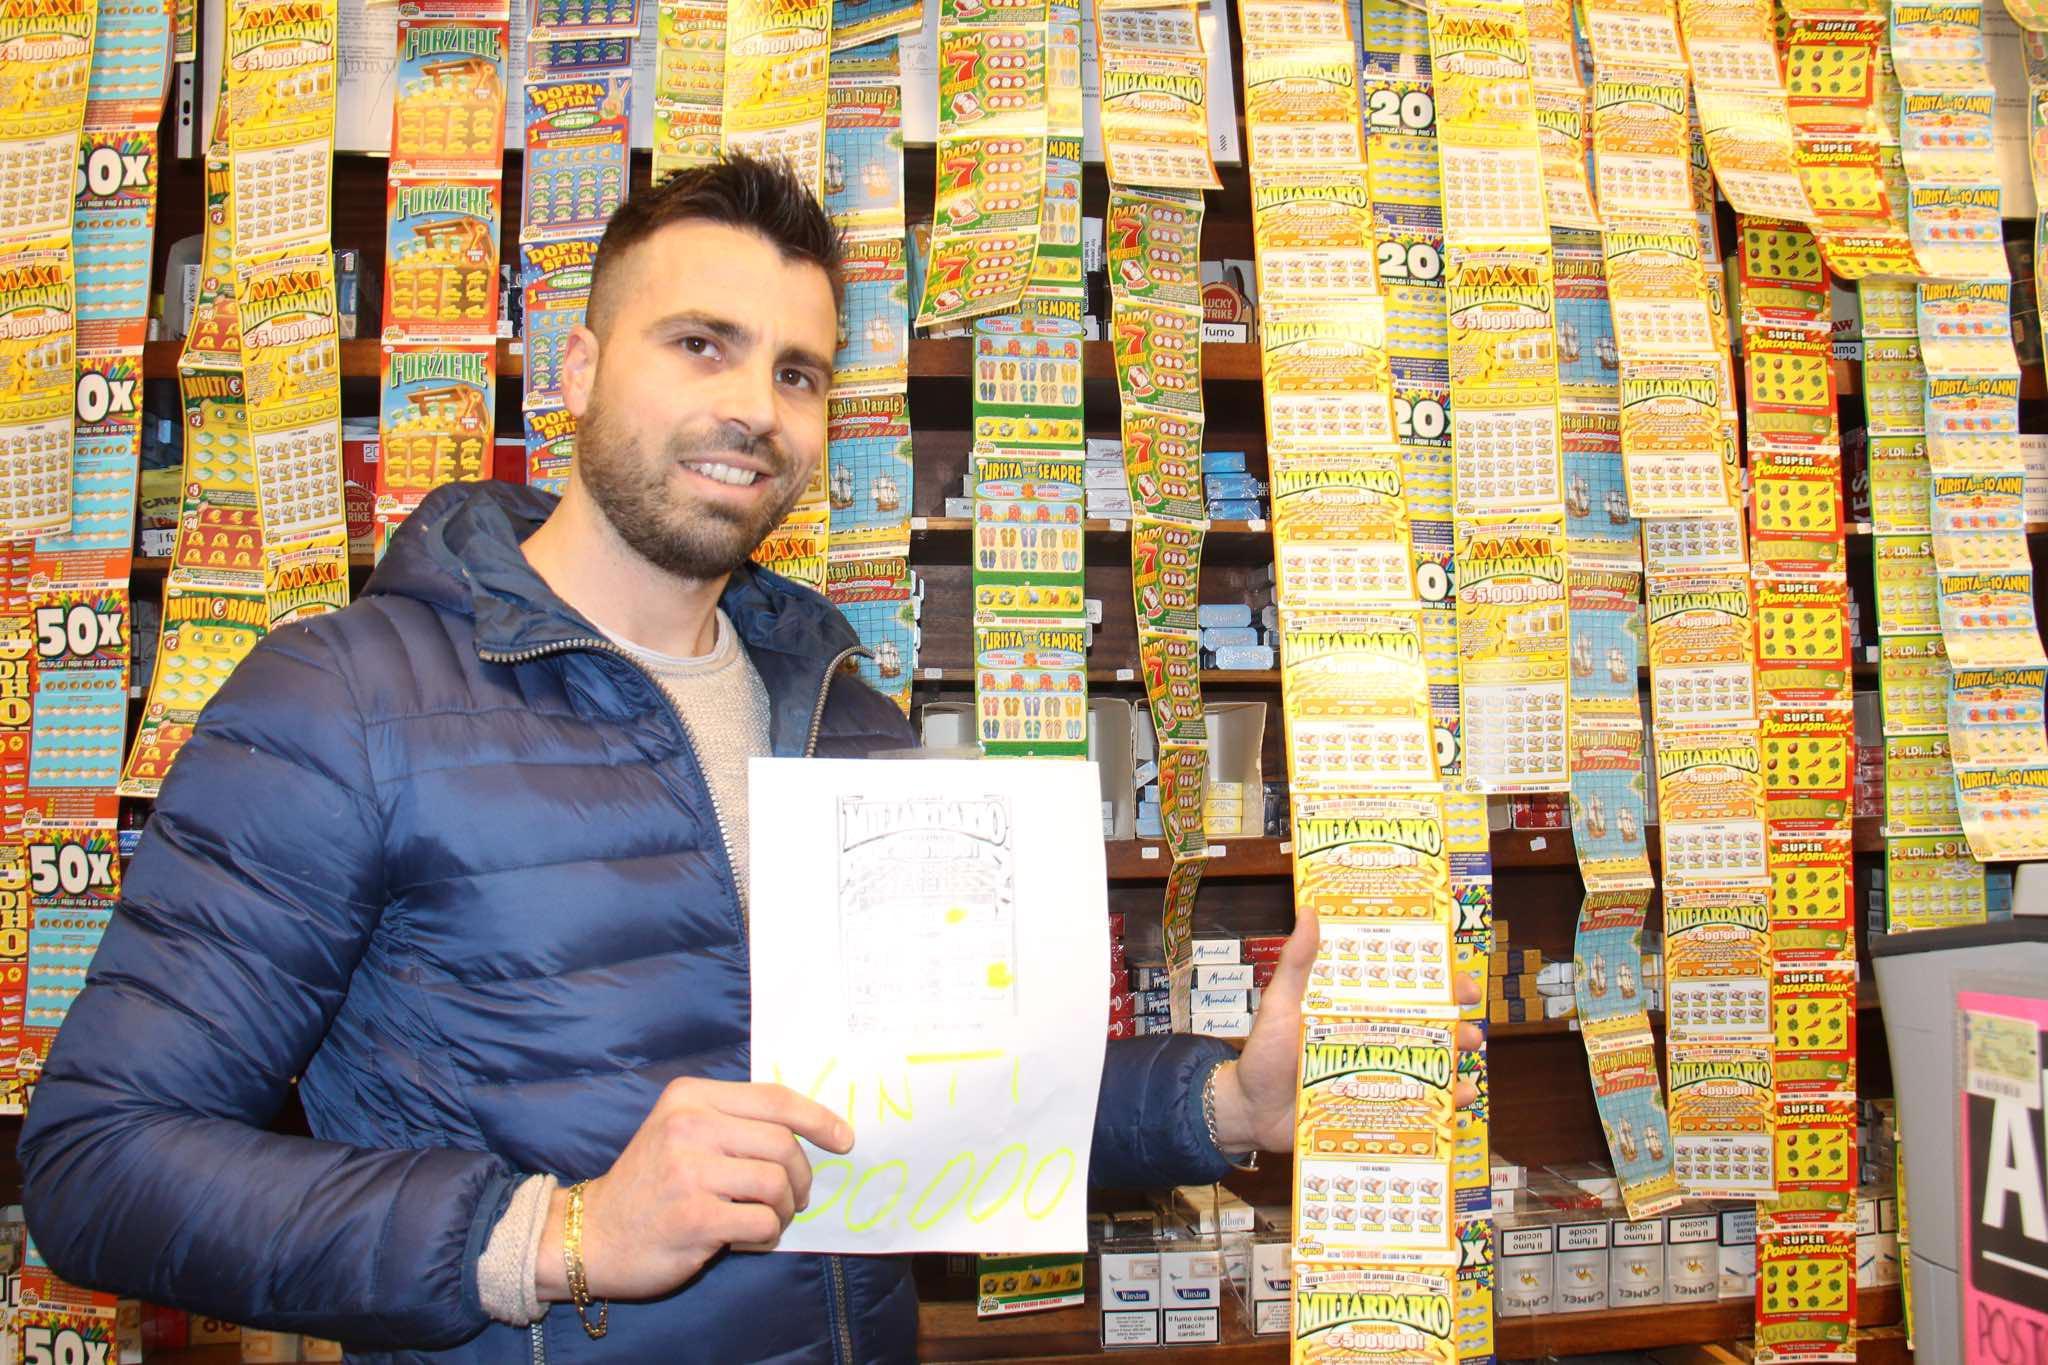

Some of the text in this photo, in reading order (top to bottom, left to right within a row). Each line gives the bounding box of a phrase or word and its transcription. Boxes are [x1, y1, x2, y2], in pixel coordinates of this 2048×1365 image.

[6, 0, 83, 17] MAXI
[244, 3, 322, 26] MAXI
[232, 16, 333, 59] MILIARDARIO
[1442, 18, 1515, 39] MAXI
[1815, 22, 1856, 32] SUPER
[405, 26, 502, 63] FORZIERE
[943, 32, 982, 52] DADO
[1433, 31, 1526, 64] MILIARDARIO
[234, 46, 334, 72] €5.000.000!
[947, 50, 981, 83] 7
[1248, 62, 1352, 88] MILIARDARIO
[532, 82, 604, 105] DOPPIA
[1104, 71, 1204, 105] MILIARDARIO
[1595, 81, 1685, 115] MILIARDARIO
[546, 96, 597, 114] SFIDA
[943, 140, 980, 159] DADO
[1812, 143, 1853, 154] SUPER
[946, 156, 979, 188] 7
[396, 185, 493, 221] FORZIERE
[1256, 185, 1368, 212] MILIARDARIO
[1115, 217, 1143, 249] 7
[527, 241, 598, 264] DOPPIA
[936, 241, 974, 264] DADO
[1606, 232, 1697, 260] MILIARDARIO
[541, 255, 591, 273] SFIDA
[936, 255, 971, 282] 7
[251, 270, 322, 299] MAXI
[1462, 265, 1540, 286] MAXI
[1449, 285, 1550, 316] MILIARDARIO
[1922, 283, 1959, 302] TURISTA
[1982, 283, 2008, 302] ANNI
[241, 291, 334, 334] MILIARDARIO
[1204, 299, 1232, 308] LUCKY
[1453, 312, 1552, 330] €5.000.000!
[245, 319, 334, 348] €5.000.000!
[1119, 325, 1147, 354] 7
[1205, 327, 1235, 337] fumo
[1768, 330, 1805, 340] SUPER
[1749, 335, 1826, 351] PORTAFORTUNA
[390, 352, 487, 388] FORZIERE
[1623, 377, 1717, 409] MILIARDARIO
[1129, 432, 1152, 464] 7
[1754, 462, 1835, 477] PORTAFORTUNA
[1775, 455, 1813, 465] SUPER
[978, 461, 1023, 482] TURISTA
[1038, 463, 1082, 486] SEMPRE
[1274, 469, 1401, 499] MILIARDARIO
[1934, 477, 1973, 497] TURISTA
[1996, 477, 2023, 497] ANNI
[348, 502, 369, 511] CKY
[1137, 543, 1158, 574] 7
[1471, 538, 1551, 559] MAXI
[280, 563, 338, 590] MAXI
[1459, 560, 1564, 591] MILIARDARIO
[1941, 576, 1980, 596] TURISTA
[2003, 575, 2031, 595] ANNI
[1461, 584, 1565, 604] €5.000.000!
[1757, 590, 1840, 606] PORTAFORTUNA
[1778, 583, 1818, 594] SUPER
[168, 598, 210, 620] MULTI
[1650, 592, 1748, 624] MILIARDARIO
[979, 631, 1023, 651] TURISTA
[1039, 632, 1083, 652] SEMPRE
[1285, 631, 1422, 669] MILIARDARIO
[1953, 671, 1993, 690] TURISTA
[2016, 668, 2045, 689] ANNI
[1783, 712, 1825, 722] SUPER
[1761, 720, 1847, 736] PORTAFORTUNA
[1660, 750, 1758, 778] MILIARDARIO
[1297, 817, 1442, 859] MILIARDARIO
[1781, 842, 1823, 852] SUPER
[1667, 906, 1768, 938] MILIARDARIO
[1783, 973, 1825, 984] SUPER
[1303, 1043, 1451, 1090] MILIARDARIO
[1670, 1062, 1770, 1090] MILIARDARIO
[772, 1053, 1021, 1122] VINTI
[1329, 1082, 1424, 1100] €500.000!
[1783, 1104, 1825, 1114] SUPER
[1568, 1228, 1597, 1236] uccide
[1624, 1224, 1653, 1232] uccide
[1679, 1229, 1701, 1237] fumo
[1680, 1221, 1708, 1229] uccide
[1513, 1233, 1543, 1241] uccide
[1513, 1242, 1534, 1250] fumo
[1568, 1237, 1590, 1245] fumo
[1623, 1233, 1646, 1241] fumo
[1782, 1234, 1825, 1245] SUPER
[1762, 1243, 1848, 1258] PORTAFORTUNA
[1363, 1272, 1371, 1280] di
[1372, 1273, 1394, 1281] premi
[1122, 1290, 1147, 1300] Winston
[1182, 1289, 1207, 1299] Winston
[1561, 1290, 1604, 1304] CAMEL
[1618, 1284, 1660, 1297] CAMEL
[1674, 1281, 1715, 1295] CAMEL
[1507, 1295, 1550, 1308] CAMEL
[1297, 1292, 1451, 1340] MILIARDARIO
[1324, 1333, 1424, 1350] €500.000!
